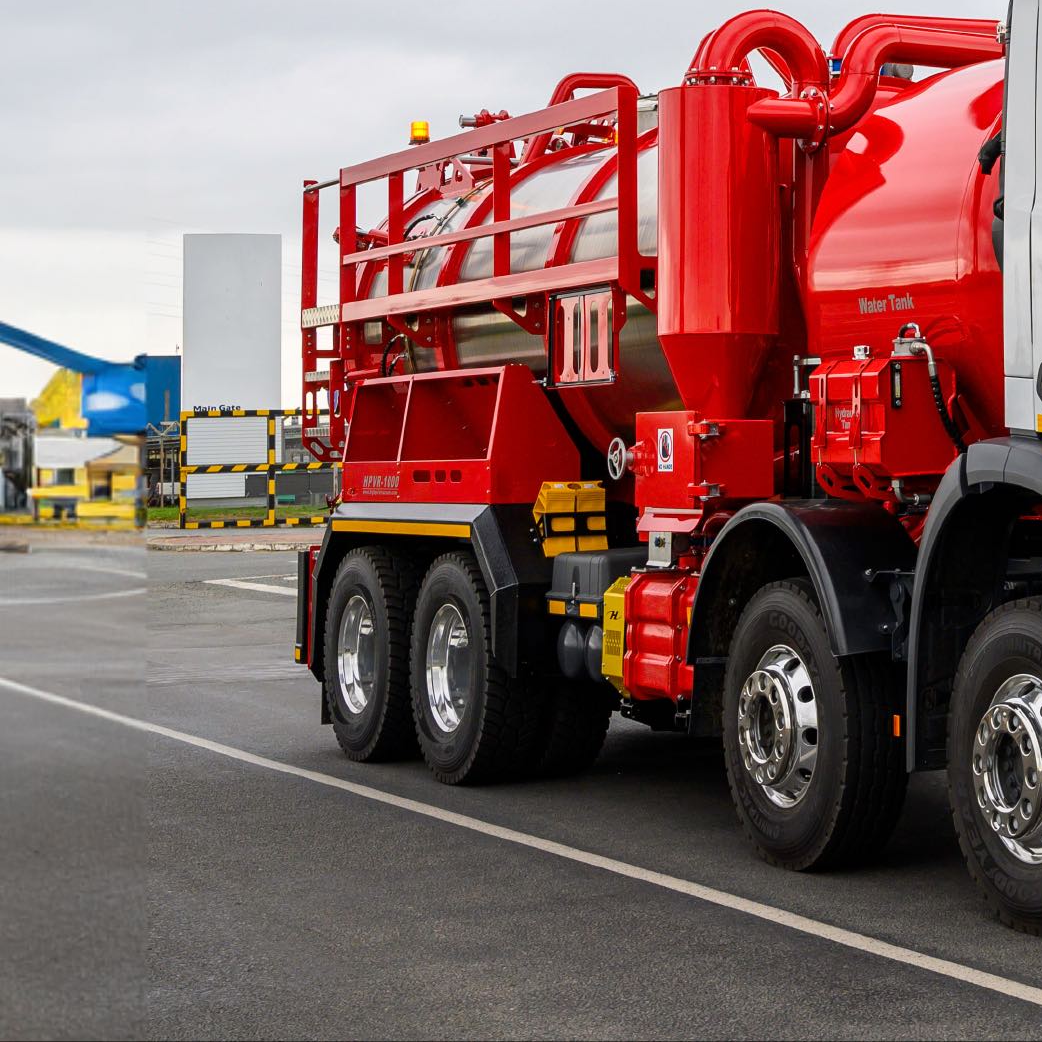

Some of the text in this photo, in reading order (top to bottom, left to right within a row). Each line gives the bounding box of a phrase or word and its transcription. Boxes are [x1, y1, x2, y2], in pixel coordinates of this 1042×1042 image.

[858, 292, 915, 315] Water Tank
[219, 404, 241, 412] Gate
